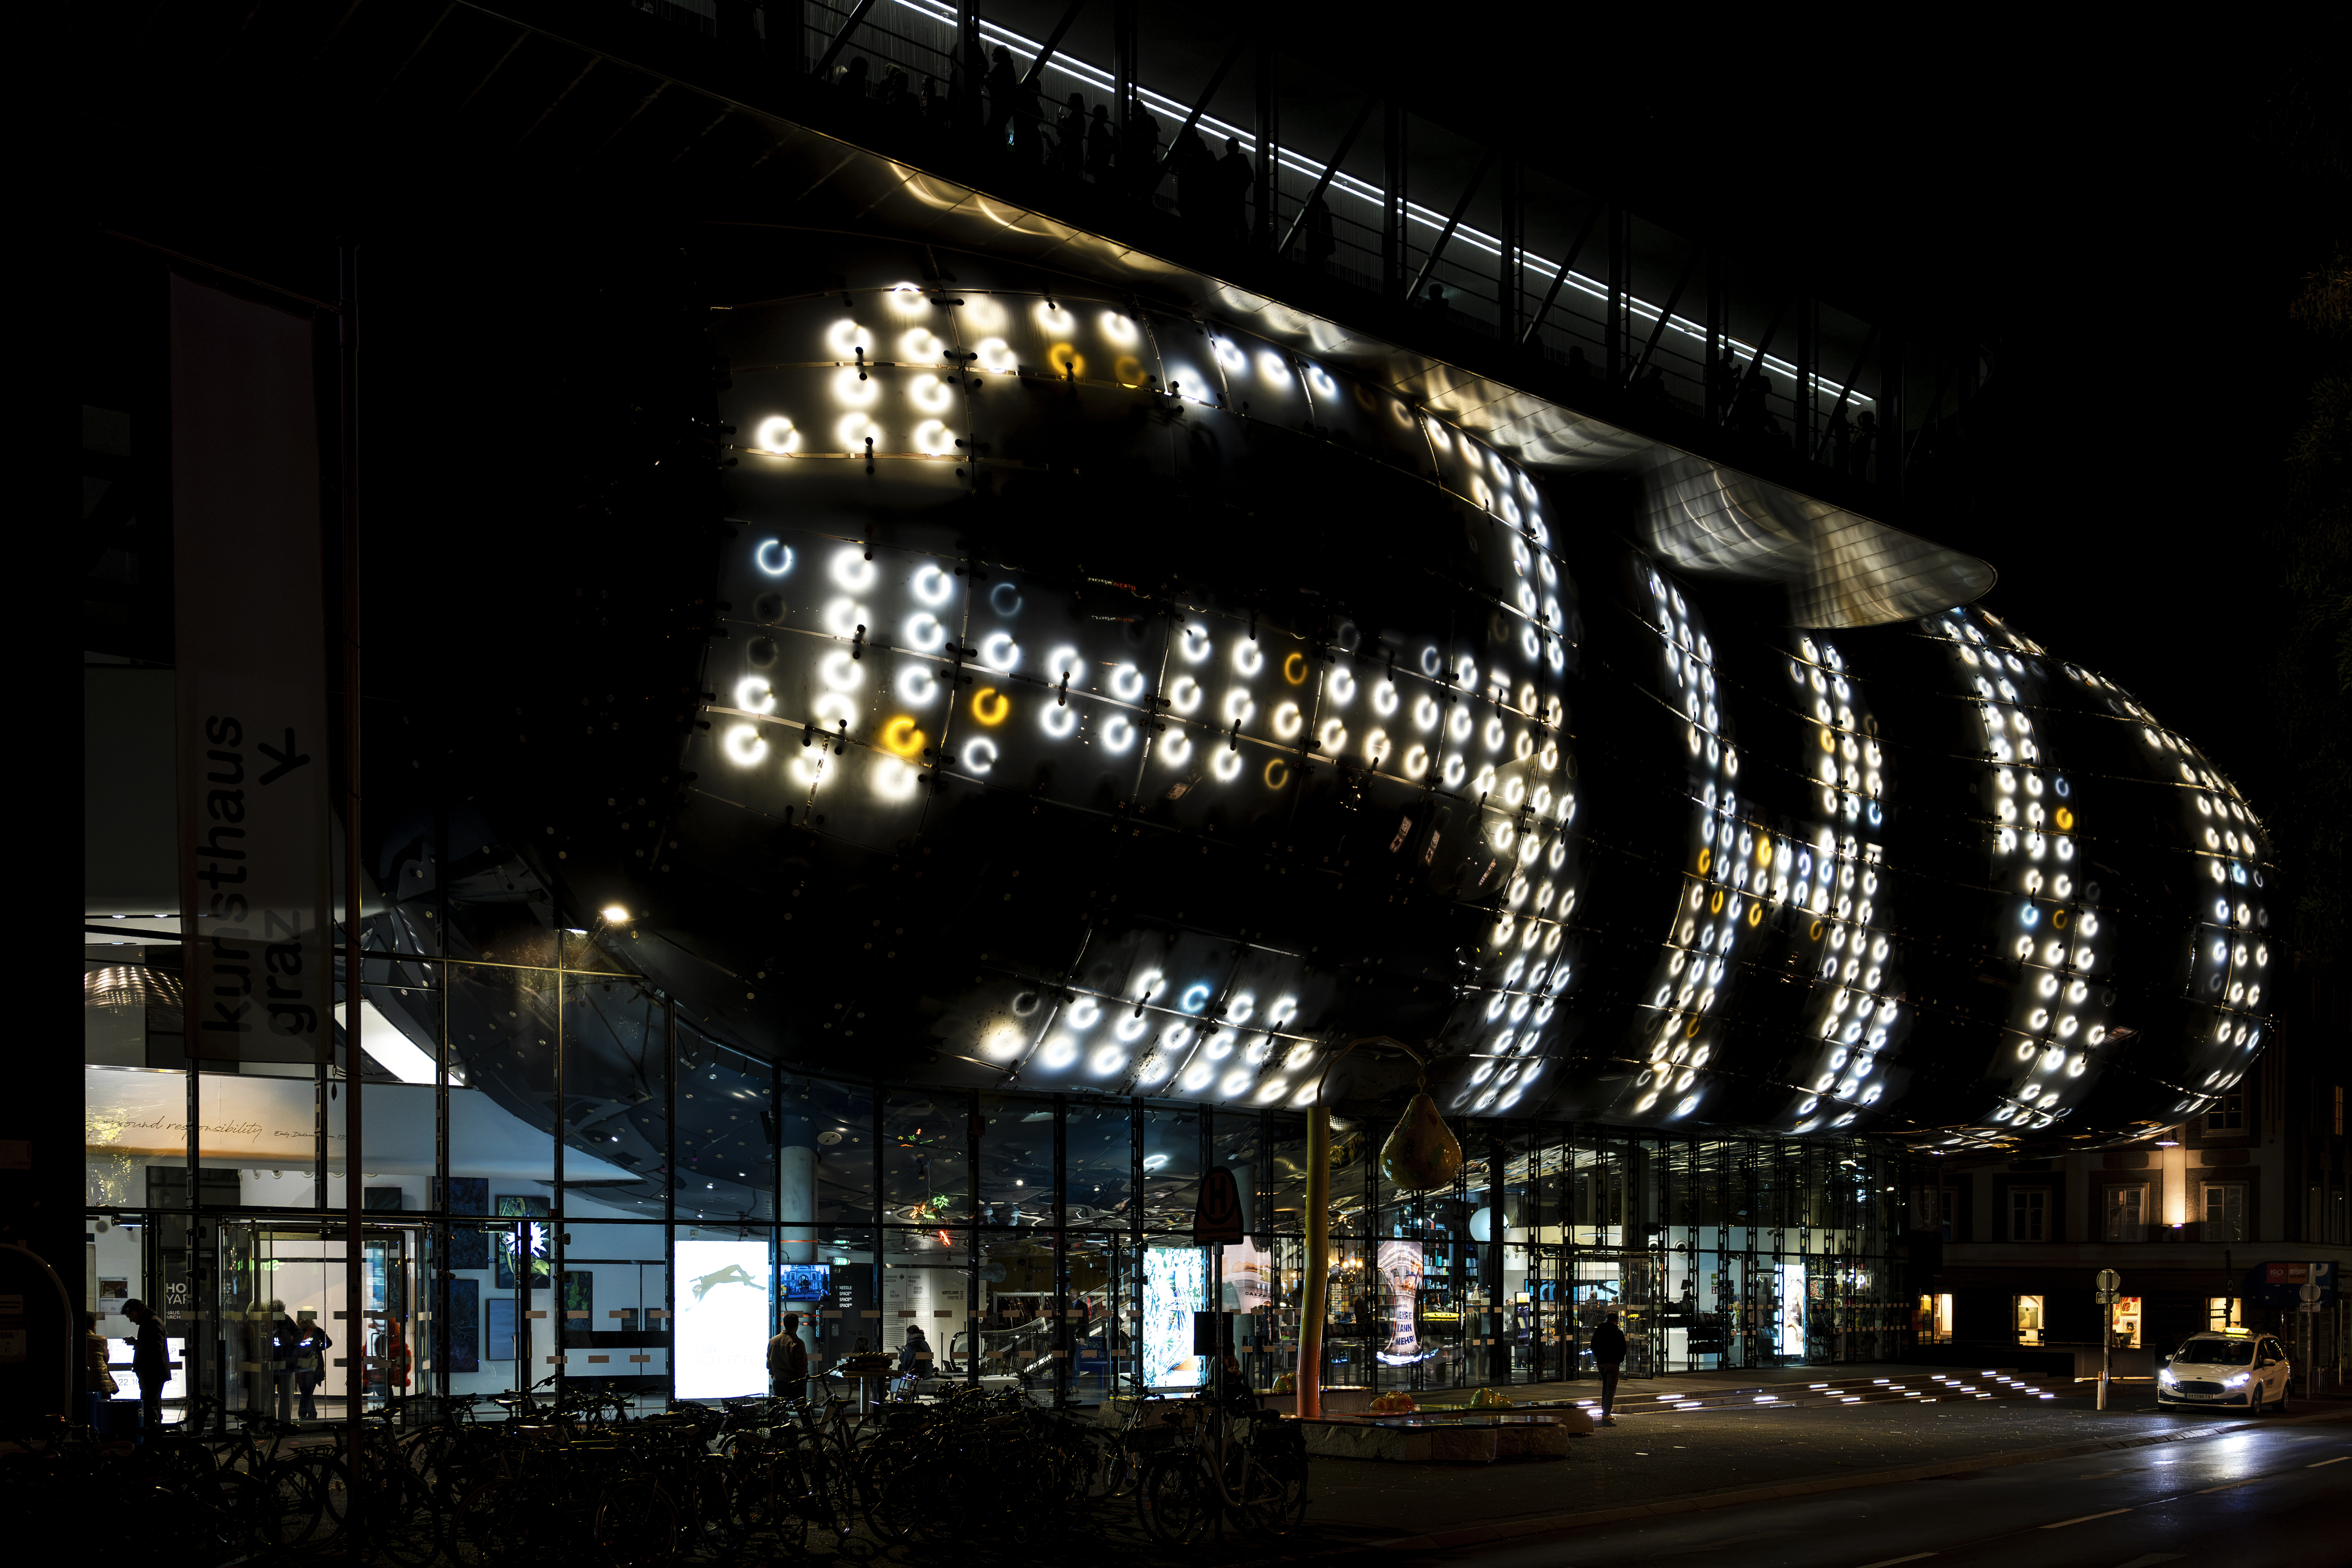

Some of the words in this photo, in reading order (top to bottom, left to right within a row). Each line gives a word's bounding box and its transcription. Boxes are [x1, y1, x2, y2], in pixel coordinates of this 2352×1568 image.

[196, 716, 252, 1032] kunsthaus
[265, 910, 317, 1035] graz
[1209, 1176, 1226, 1214] H
[1396, 1335, 1415, 1345] MEHR!
[1397, 1323, 1412, 1332] KANN
